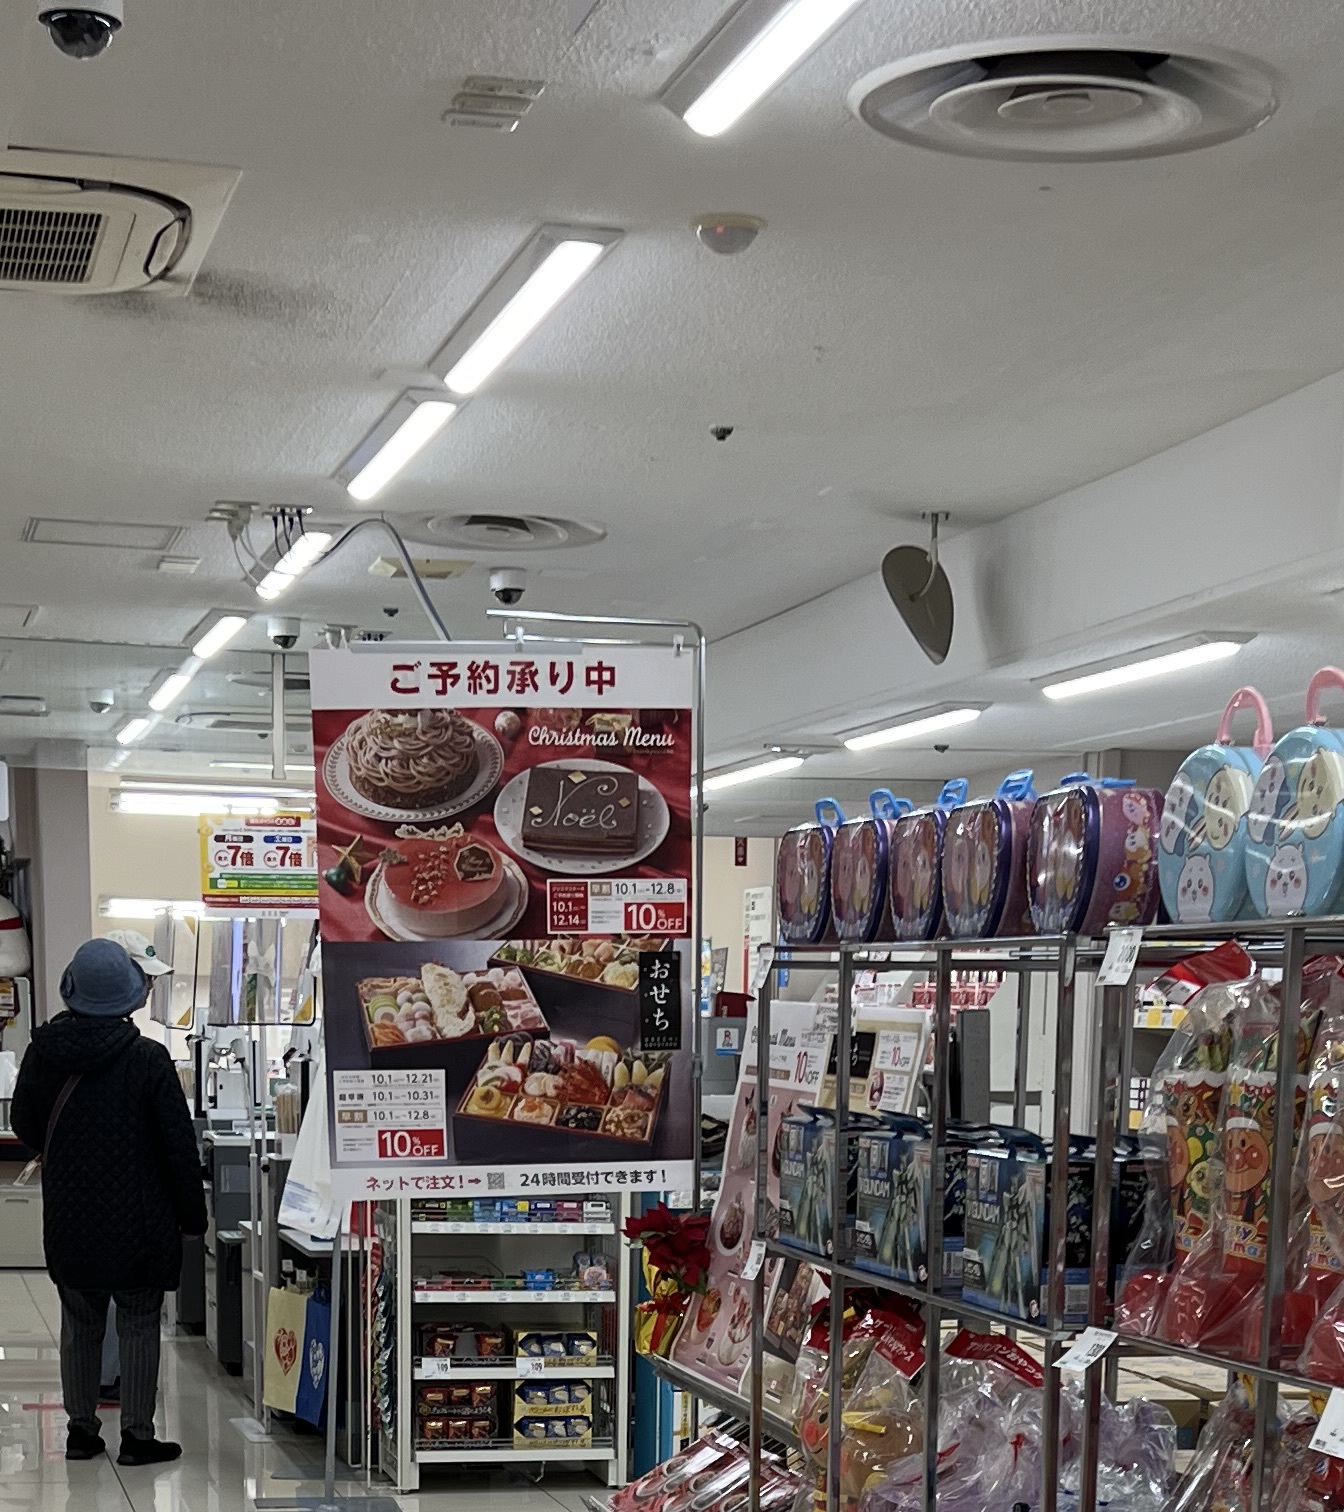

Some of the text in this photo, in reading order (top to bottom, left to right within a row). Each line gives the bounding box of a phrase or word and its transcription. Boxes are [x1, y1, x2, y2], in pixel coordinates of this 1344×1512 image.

[389, 660, 617, 696] ご予約承り中
[527, 725, 676, 748] Christmas Menu
[530, 776, 619, 830] Noël
[648, 958, 671, 1033] おせち
